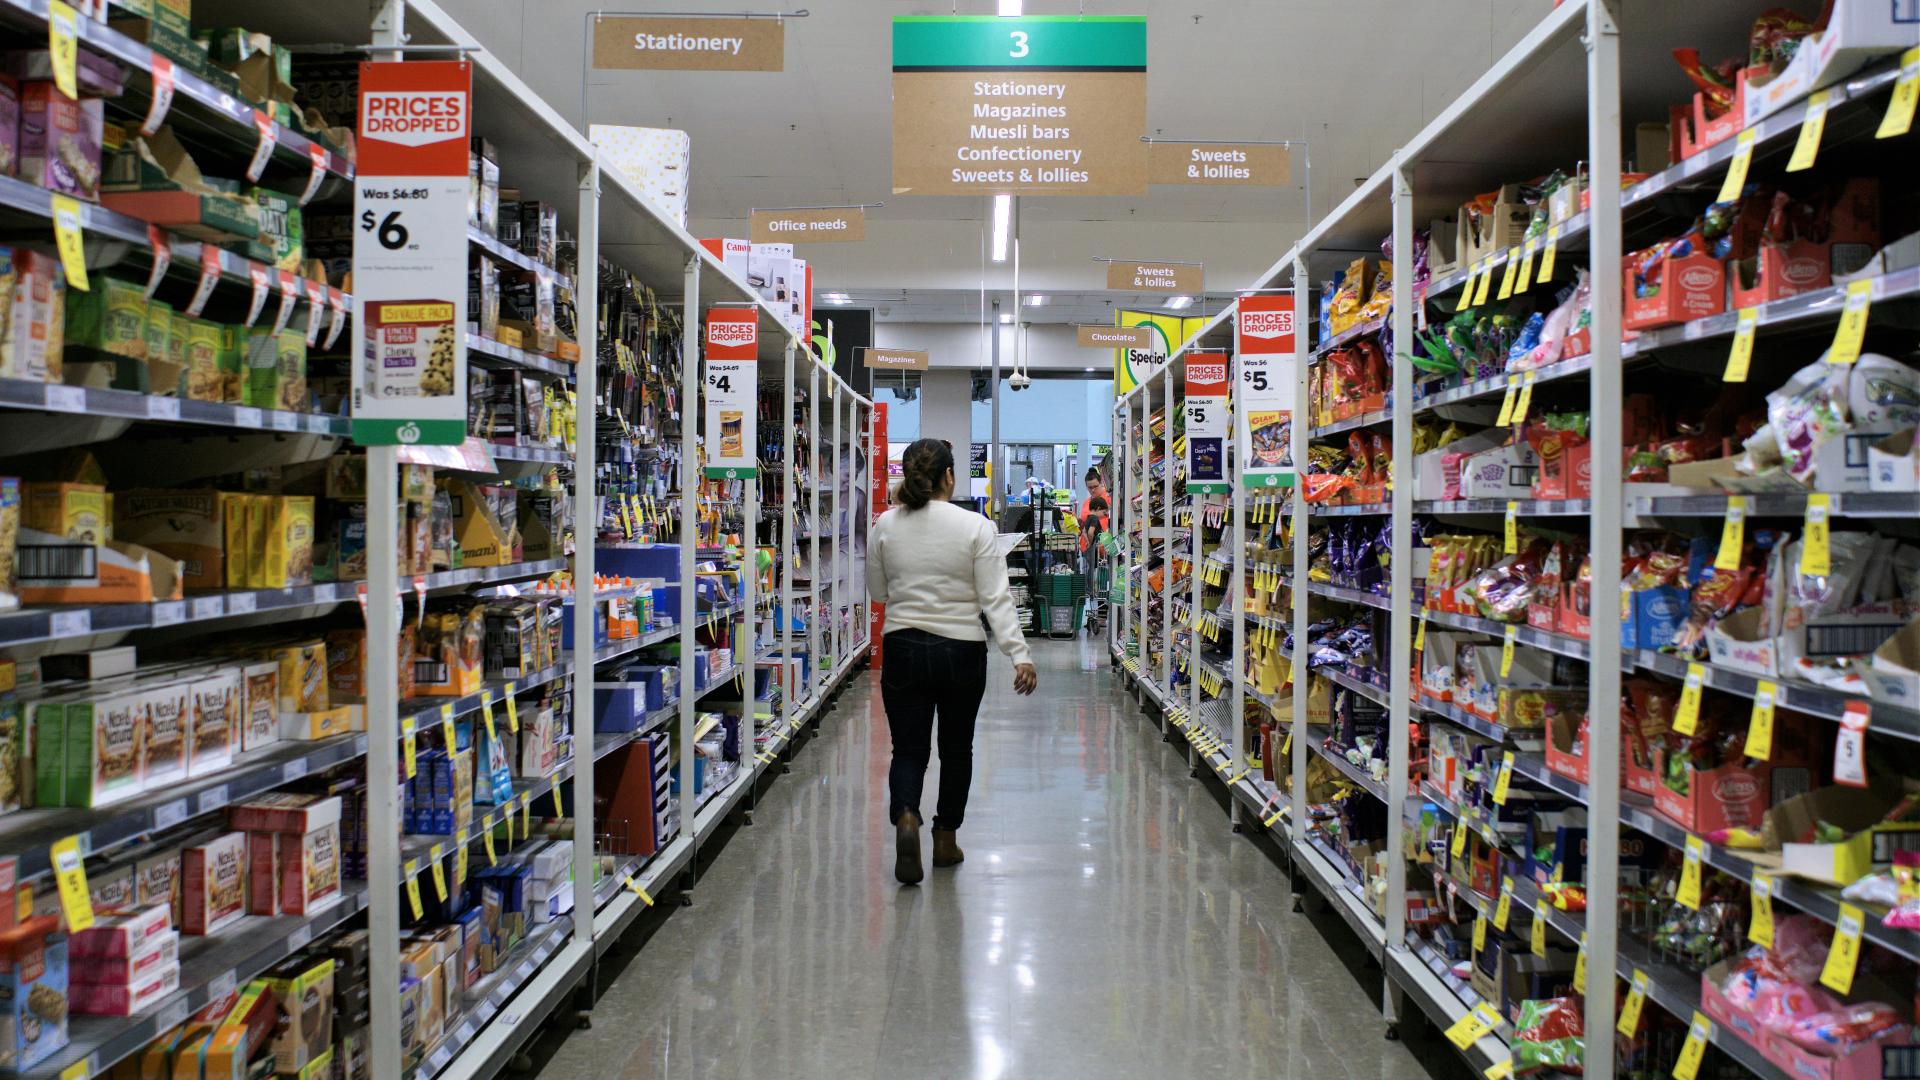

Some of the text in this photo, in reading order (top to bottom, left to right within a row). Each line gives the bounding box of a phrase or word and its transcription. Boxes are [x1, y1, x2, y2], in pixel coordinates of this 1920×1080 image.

[634, 33, 743, 55] Stationery
[1009, 31, 1030, 58] 3
[973, 81, 1066, 99] Stationery
[368, 97, 460, 116] PRICES
[973, 103, 1067, 120] Magazines
[368, 118, 460, 132] DROPPED
[970, 125, 1070, 139] Muesli bars
[957, 147, 1082, 164] Confectionery
[1191, 148, 1247, 162] Sweets
[951, 168, 1089, 183] Sweets & lollies
[1187, 165, 1250, 178] & lollies
[363, 189, 389, 200] Was
[361, 210, 409, 251] $6
[769, 219, 847, 231] Office needs
[726, 242, 751, 252] Canon
[1136, 266, 1175, 276] Sweets
[1134, 277, 1176, 288] & lollies
[1244, 313, 1292, 324] PRICES
[711, 325, 753, 333] PRICES
[1244, 324, 1292, 333] DROPPED
[1091, 333, 1137, 342] Chocolates
[877, 355, 916, 364] Magazines
[1188, 366, 1223, 374] PRICES
[708, 374, 731, 393] $4
[1244, 370, 1268, 391] $5
[1188, 408, 1206, 423] $5
[1251, 415, 1276, 425] GIANT
